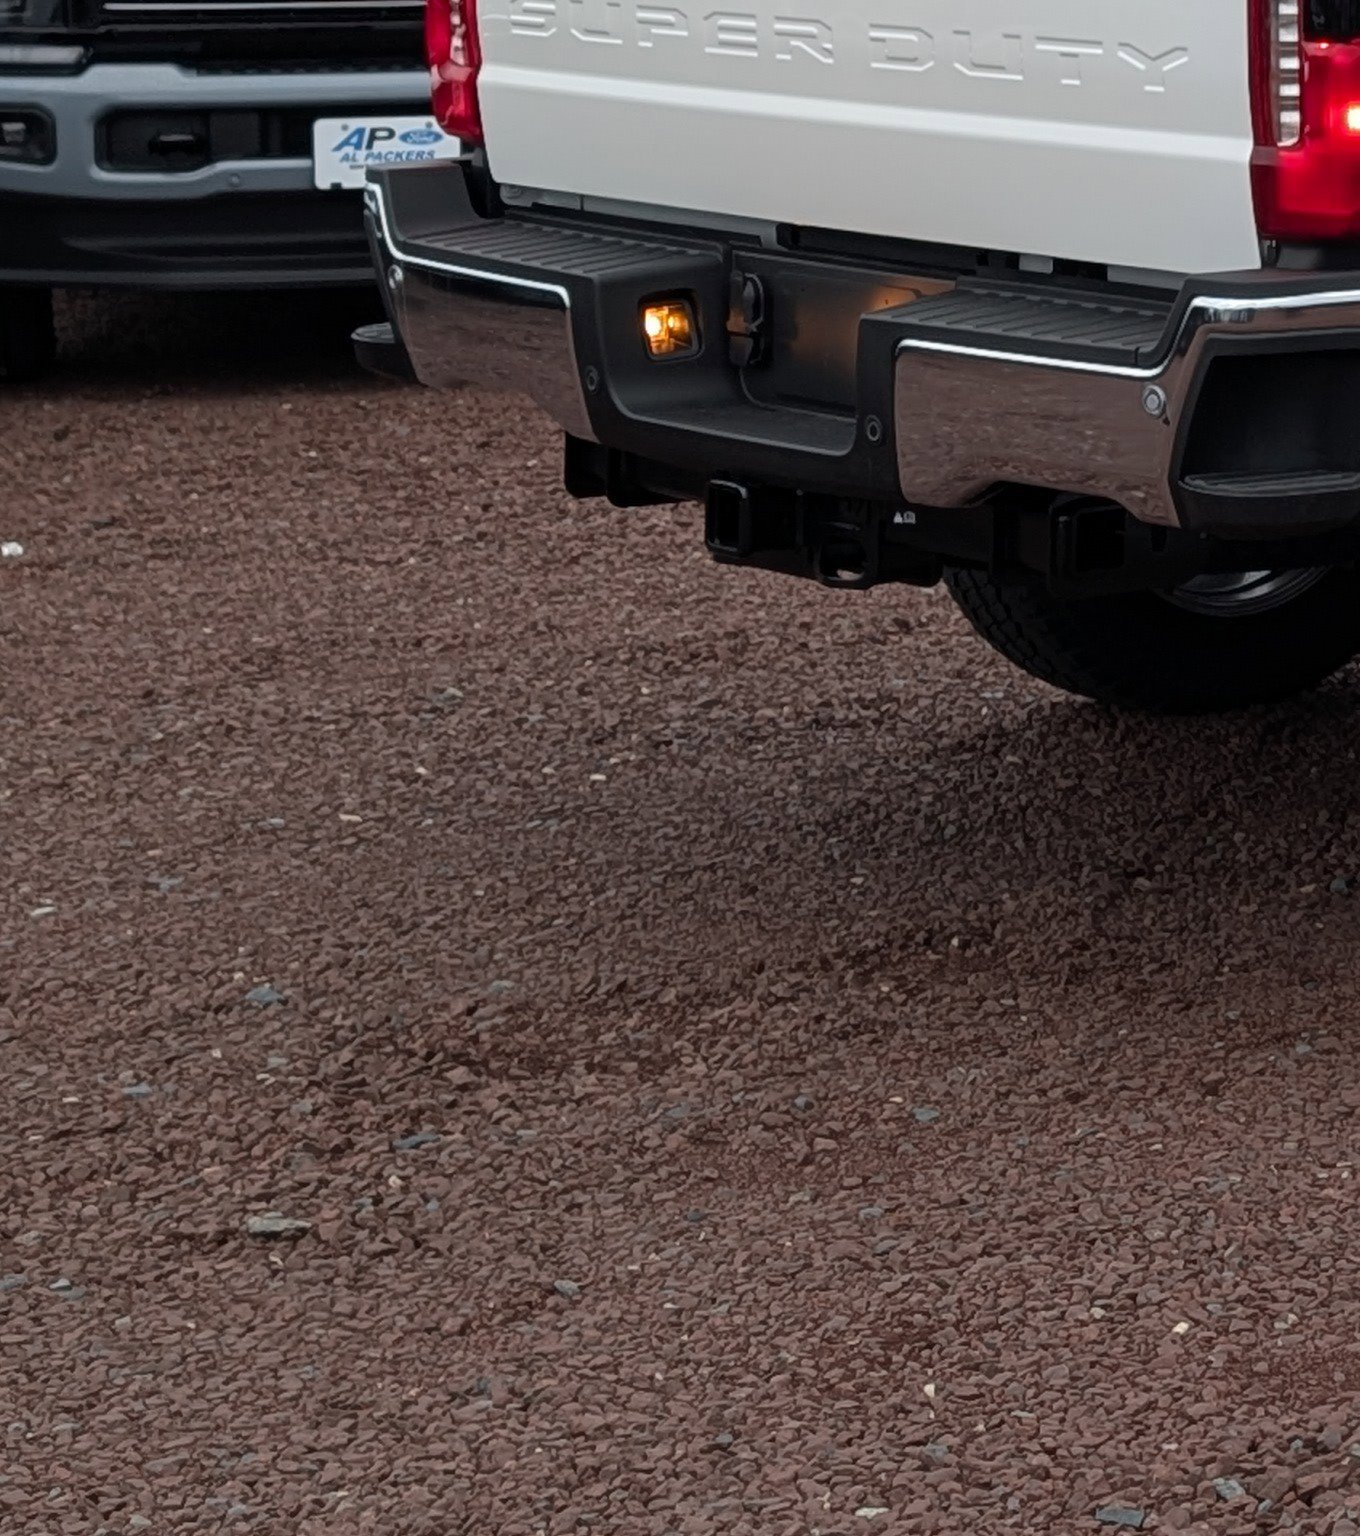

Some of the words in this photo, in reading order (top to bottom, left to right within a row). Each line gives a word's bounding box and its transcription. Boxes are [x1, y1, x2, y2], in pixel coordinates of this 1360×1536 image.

[868, 22, 1189, 91] DUTY
[332, 127, 396, 152] AP
[340, 152, 358, 163] AL
[365, 150, 435, 162] PACKERS
